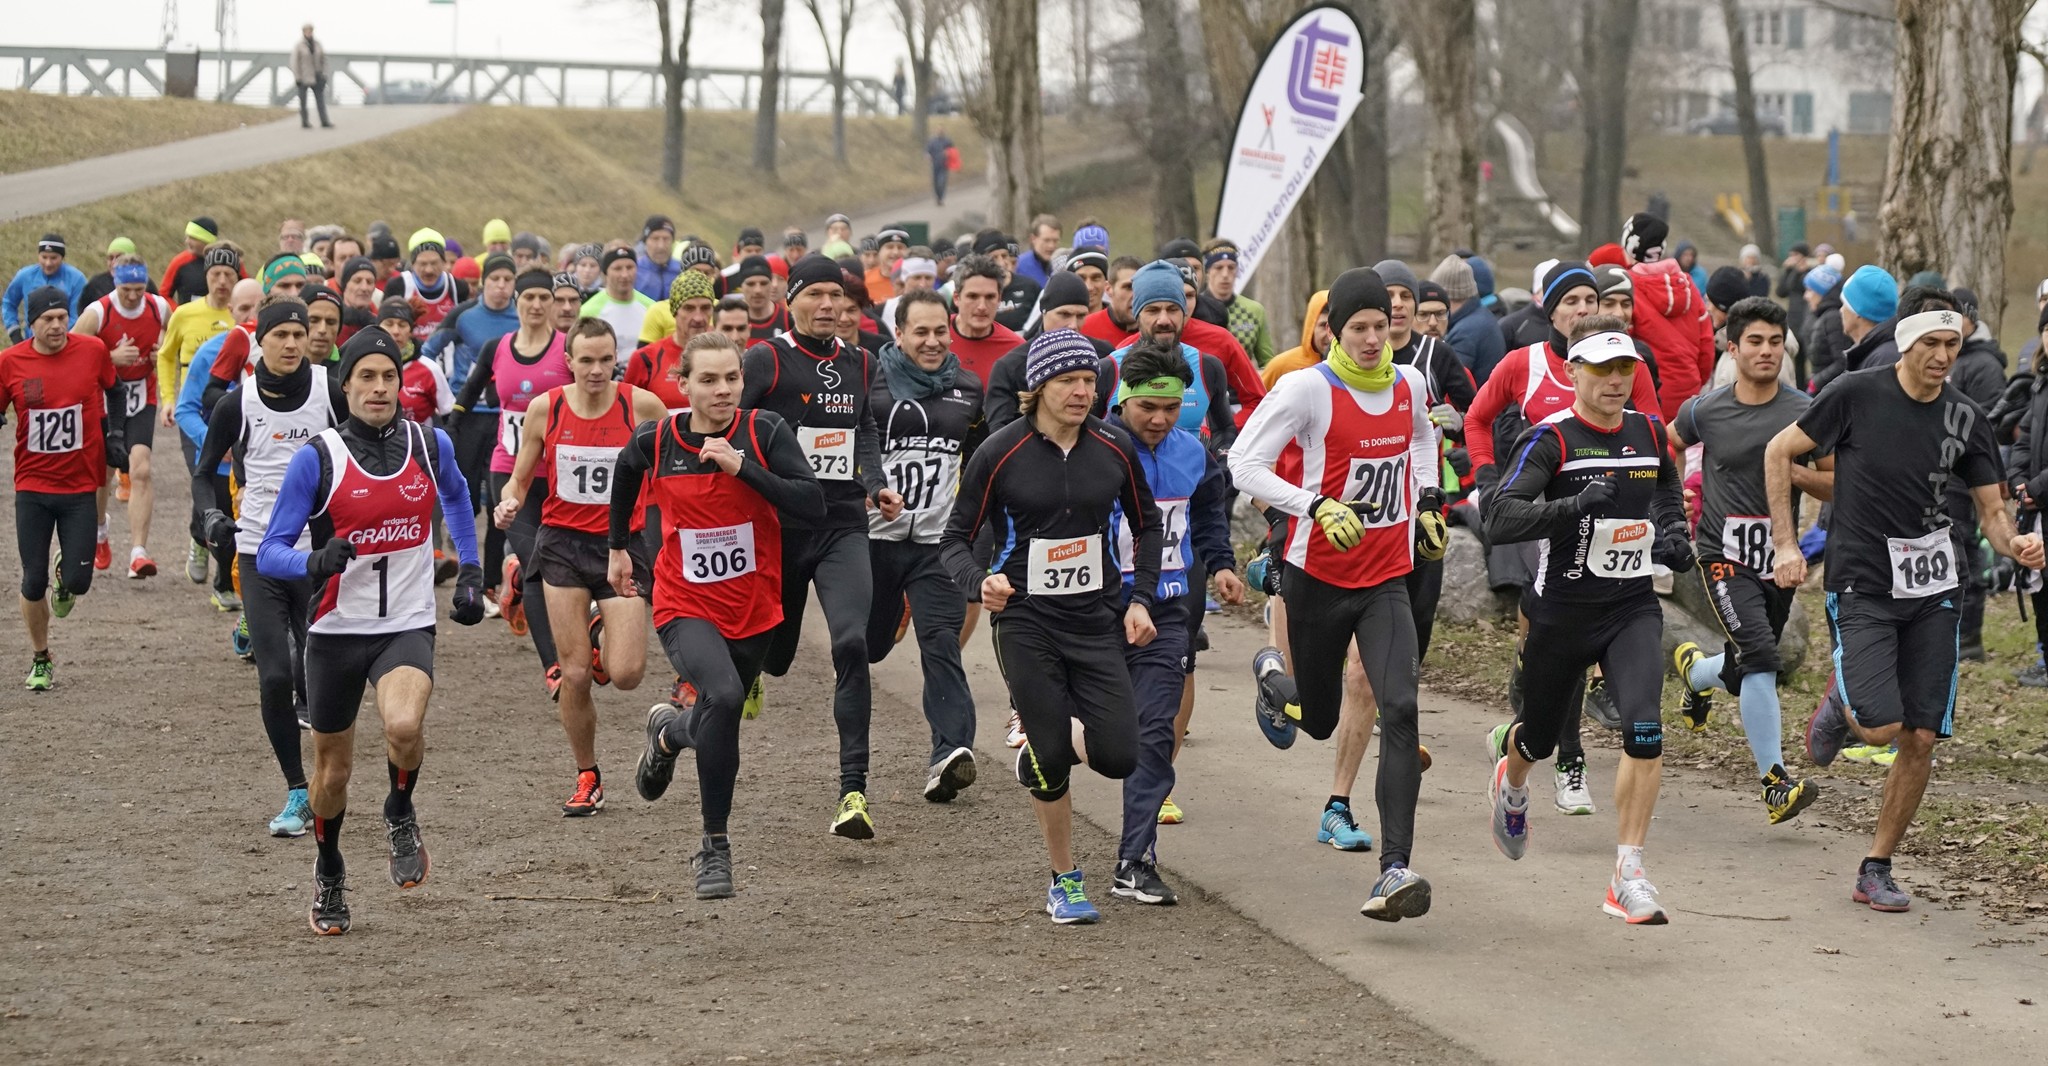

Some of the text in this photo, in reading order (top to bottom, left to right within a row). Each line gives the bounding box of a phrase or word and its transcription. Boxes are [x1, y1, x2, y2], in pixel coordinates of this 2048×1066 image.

[817, 392, 855, 405] SPORT
[35, 409, 76, 452] 129
[818, 432, 845, 447] rivella
[1360, 434, 1406, 449] TS DORNBIRN
[809, 454, 849, 475] 373
[572, 465, 609, 494] 19
[890, 457, 943, 512] 107
[1351, 456, 1405, 524] 200
[382, 517, 409, 526] erdgas
[347, 523, 422, 545] GRAVAG
[694, 528, 738, 539] VORARLBERGER
[695, 534, 738, 545] SPORTVERBAND
[1616, 525, 1646, 541] rivella
[1052, 542, 1084, 558] rivella
[1602, 549, 1644, 572] 378
[691, 547, 747, 579] 306
[1709, 562, 1736, 581] 31
[1897, 550, 1950, 589] 180
[372, 555, 389, 618] 1
[1043, 565, 1091, 589] 376
